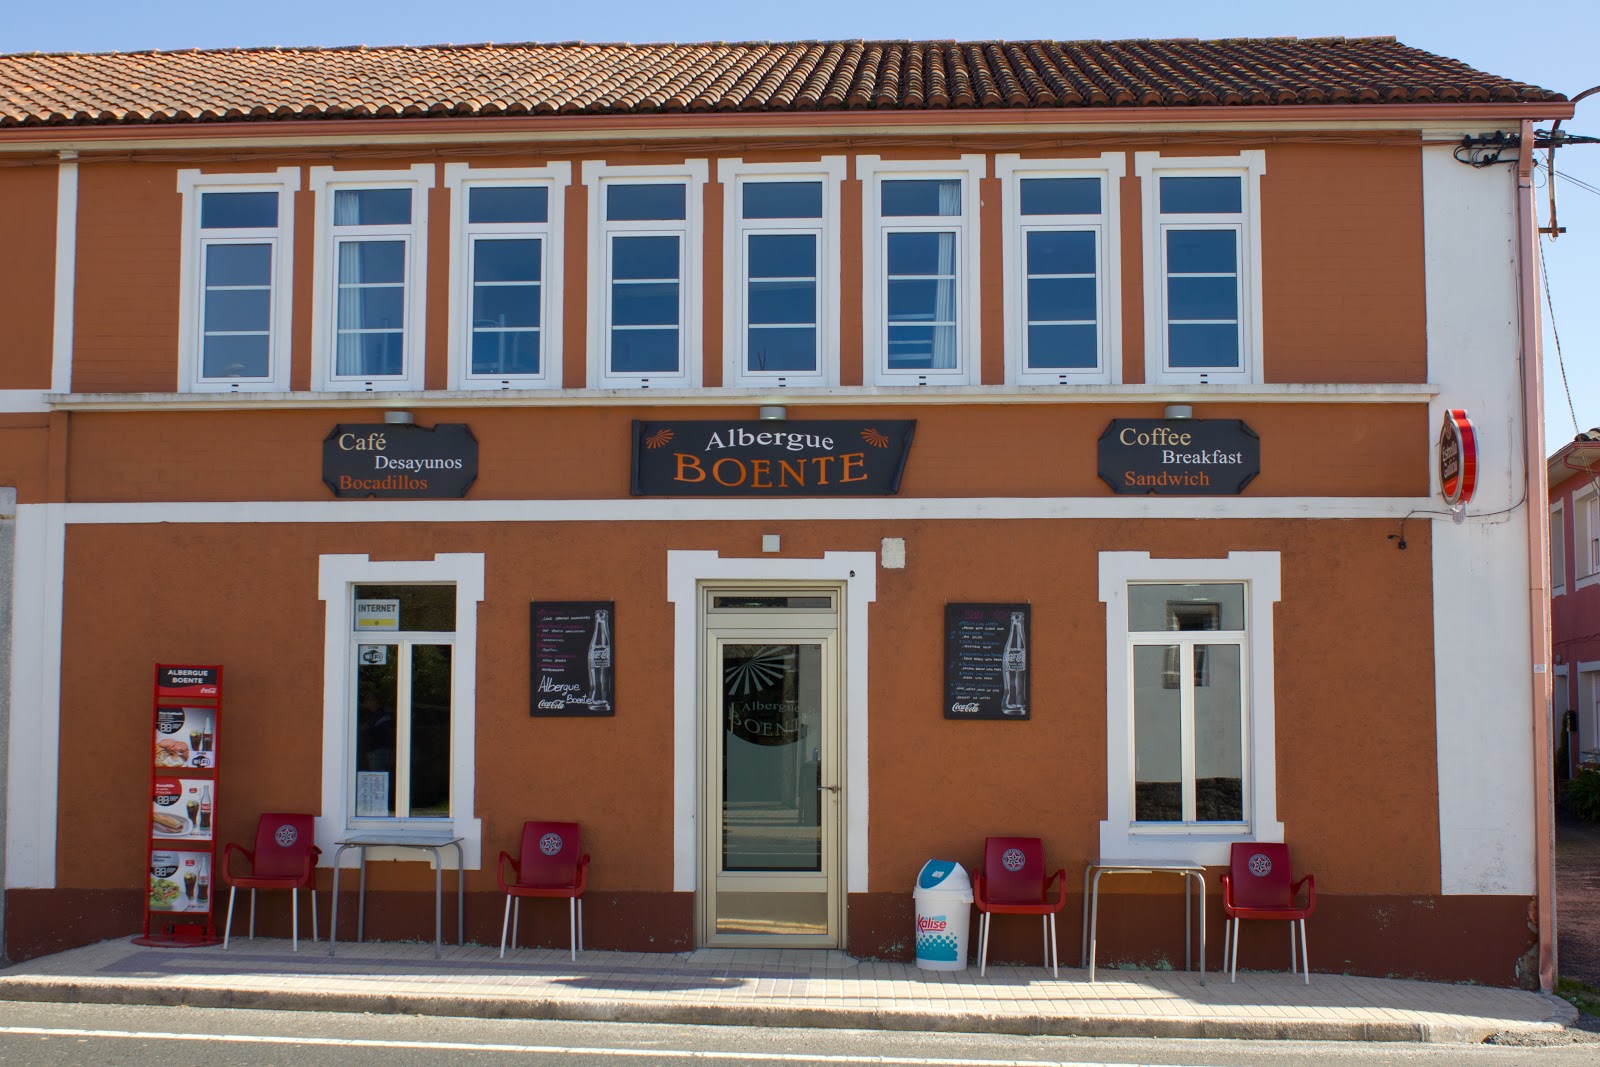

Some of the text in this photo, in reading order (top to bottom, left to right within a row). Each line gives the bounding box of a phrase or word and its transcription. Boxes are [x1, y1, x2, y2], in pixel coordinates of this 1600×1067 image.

[338, 433, 387, 451] Café
[704, 428, 834, 451] Albergue
[1119, 427, 1192, 446] Coffee
[374, 455, 462, 472] Desayunos
[1161, 449, 1243, 464] Breakfast
[673, 452, 868, 488] BOENTE
[1124, 470, 1210, 486] Sandwich
[339, 475, 428, 490] Bocadillos
[358, 604, 396, 612] INTERNET
[168, 669, 208, 677] ALBERGUE
[538, 675, 580, 696] Albergue
[742, 701, 801, 713] Albergue
[917, 914, 947, 933] Kalise
